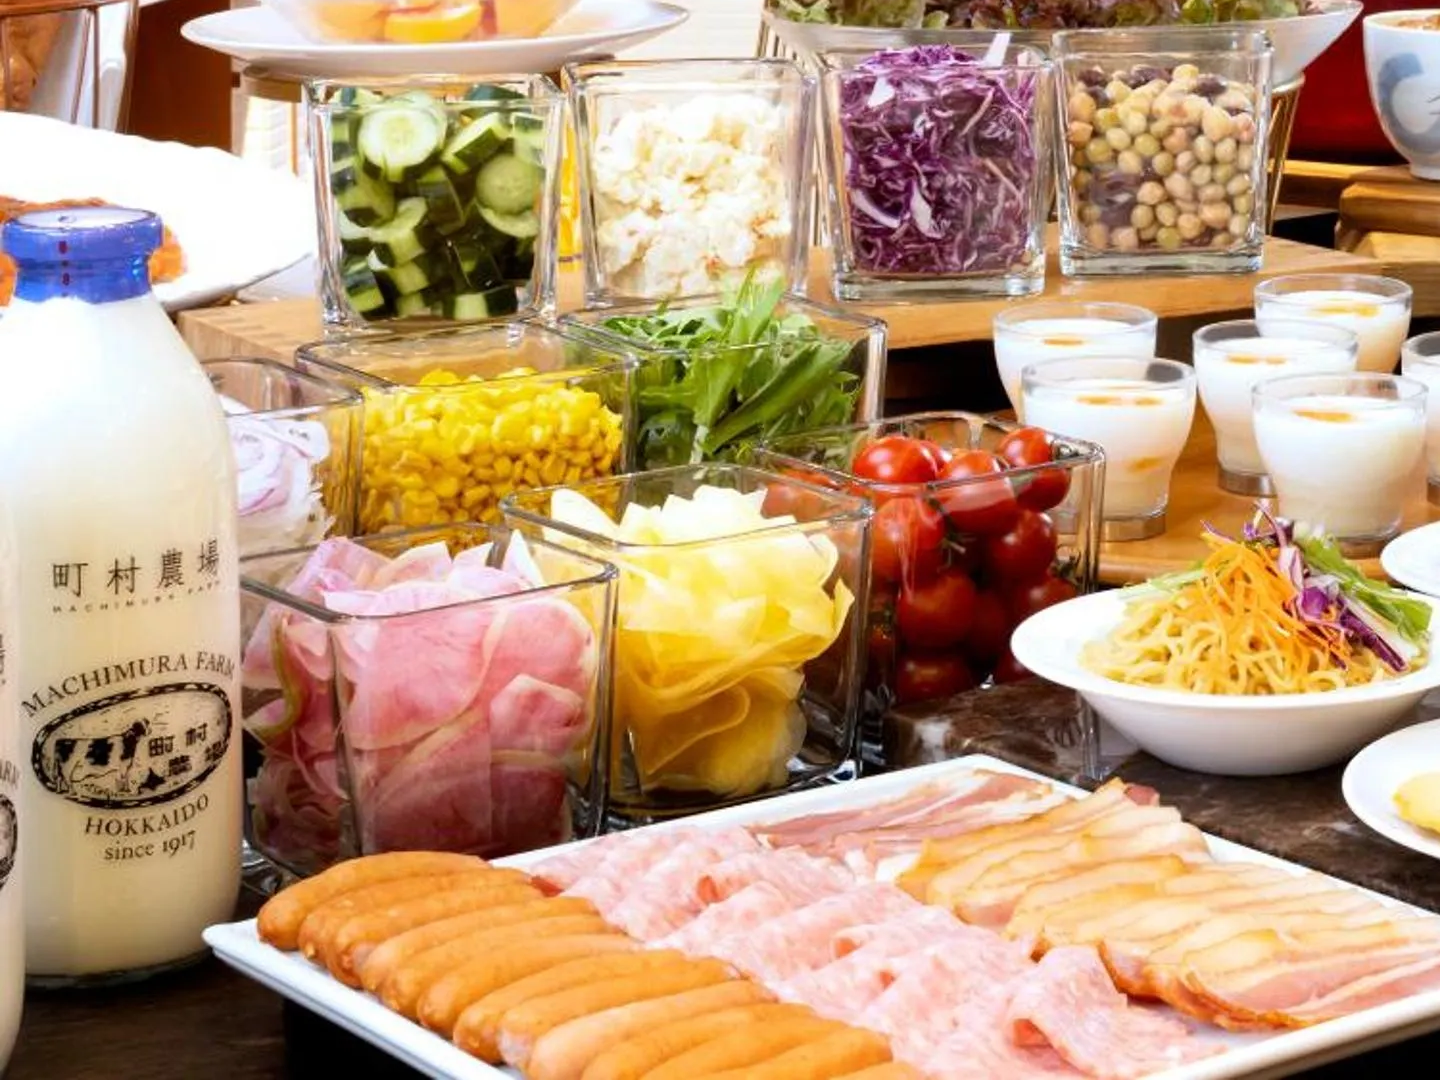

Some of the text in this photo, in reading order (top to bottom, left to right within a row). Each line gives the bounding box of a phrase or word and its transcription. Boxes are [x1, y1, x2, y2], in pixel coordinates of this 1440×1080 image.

[53, 537, 219, 598] 町村農場
[21, 653, 188, 717] MACHIMURA
[196, 651, 235, 681] FARM
[85, 794, 209, 837] HOKKAIDO
[104, 830, 197, 861] since 1917
